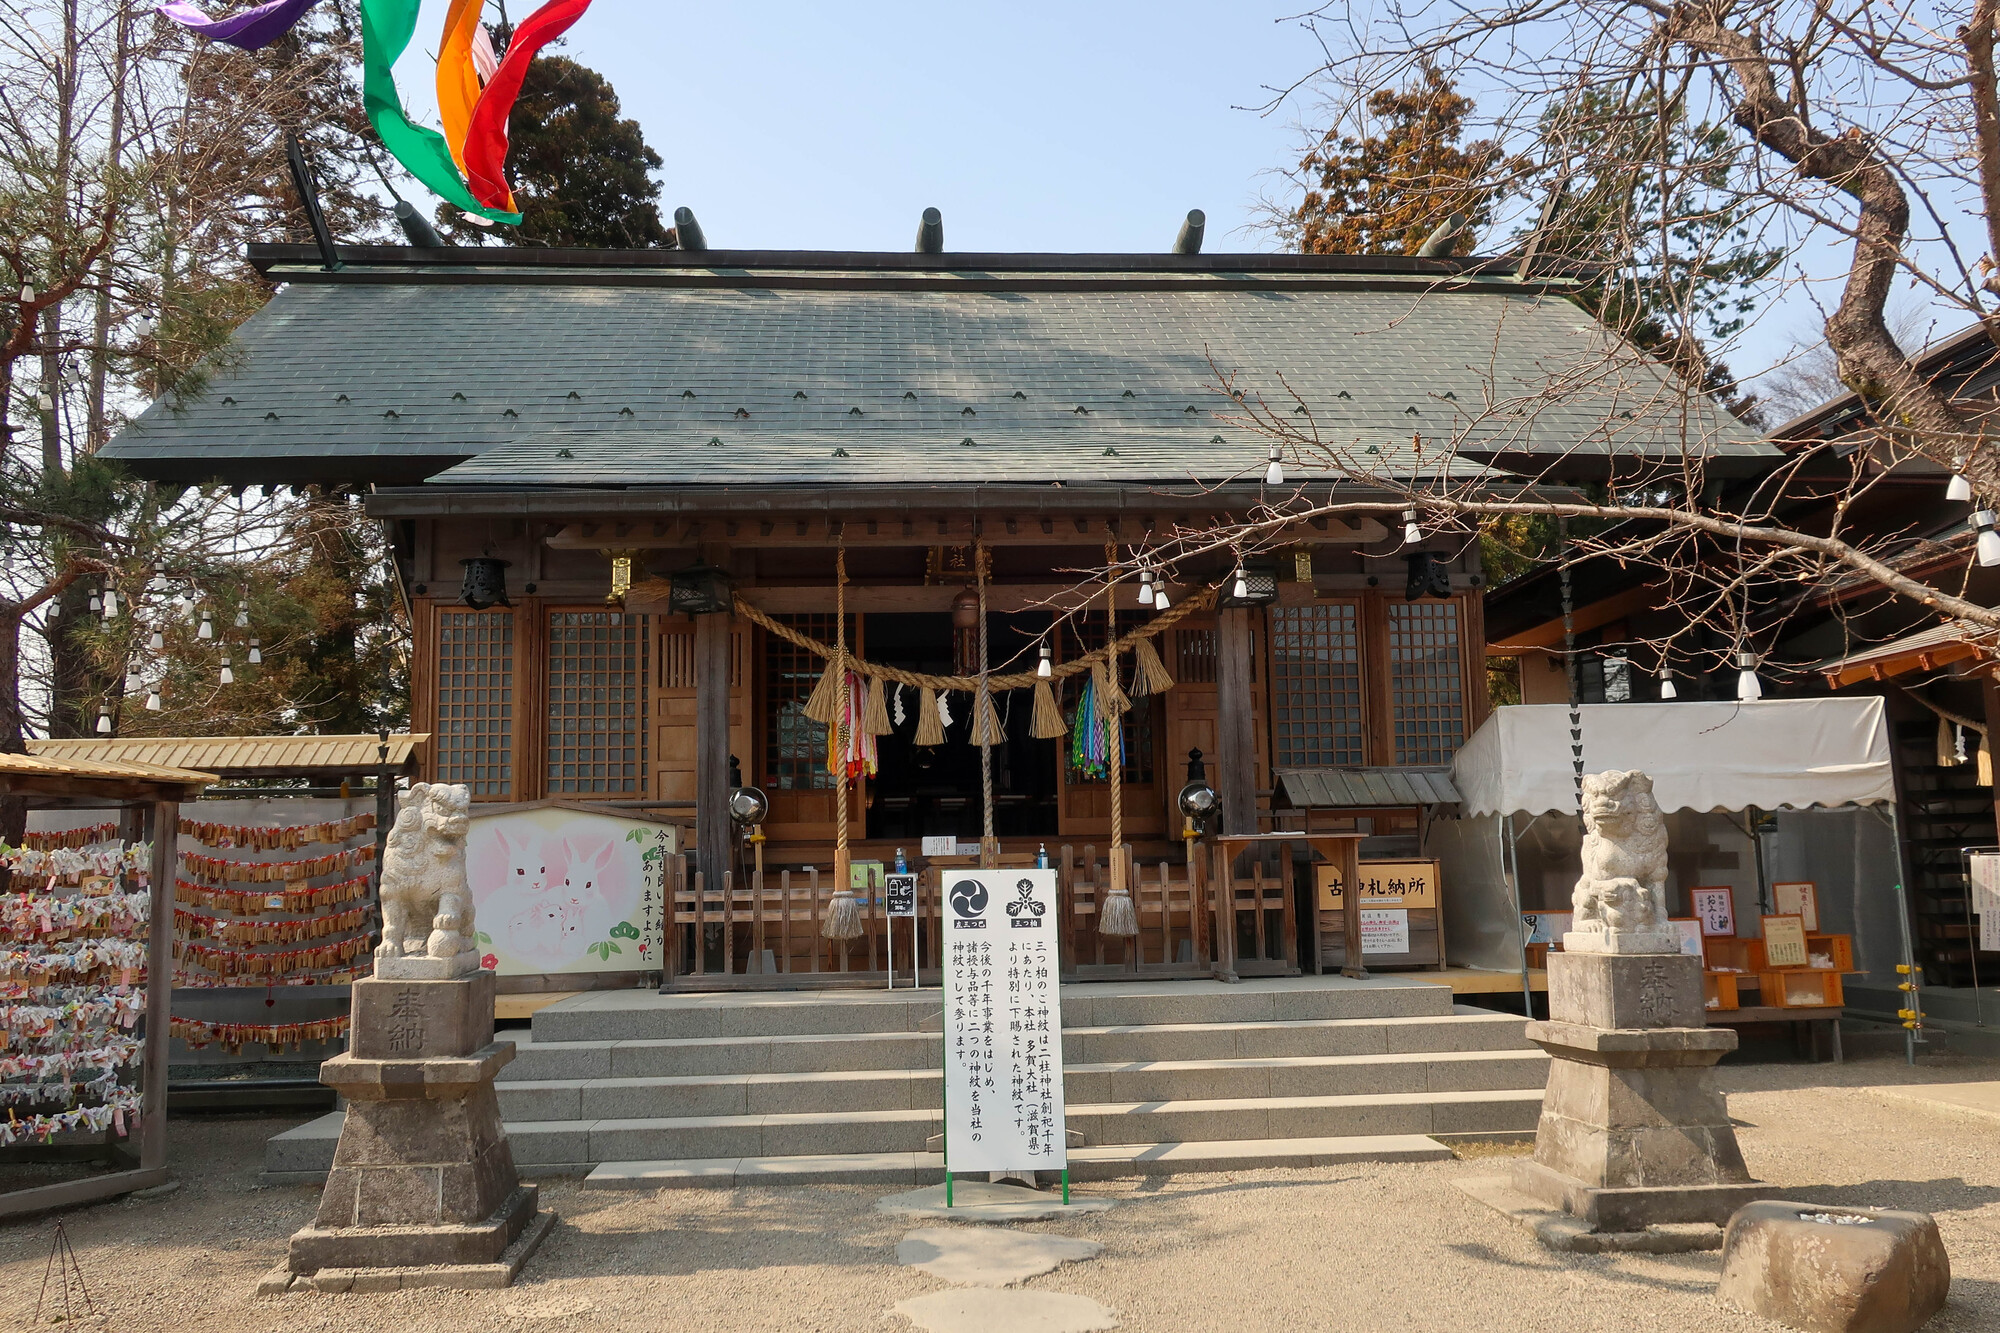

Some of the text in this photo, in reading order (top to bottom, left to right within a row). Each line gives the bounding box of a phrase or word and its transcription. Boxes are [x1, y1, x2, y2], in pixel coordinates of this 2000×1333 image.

[642, 860, 654, 961] ありますように
[1707, 894, 1719, 931] おみくじ
[387, 988, 429, 1051] 奉納
[952, 940, 967, 1068] 神紋として参ります。
[966, 940, 983, 1142] 諸授与品等に二つの神紋を当社の
[980, 940, 996, 1094] 今後の千年事業をはじめ、
[1008, 942, 1025, 1136] より特別に下賜された神紋です。
[1035, 941, 1054, 1157] 三つ柏のご神紋は二柱神社創祀千年
[1640, 960, 1680, 1019] 奉納
